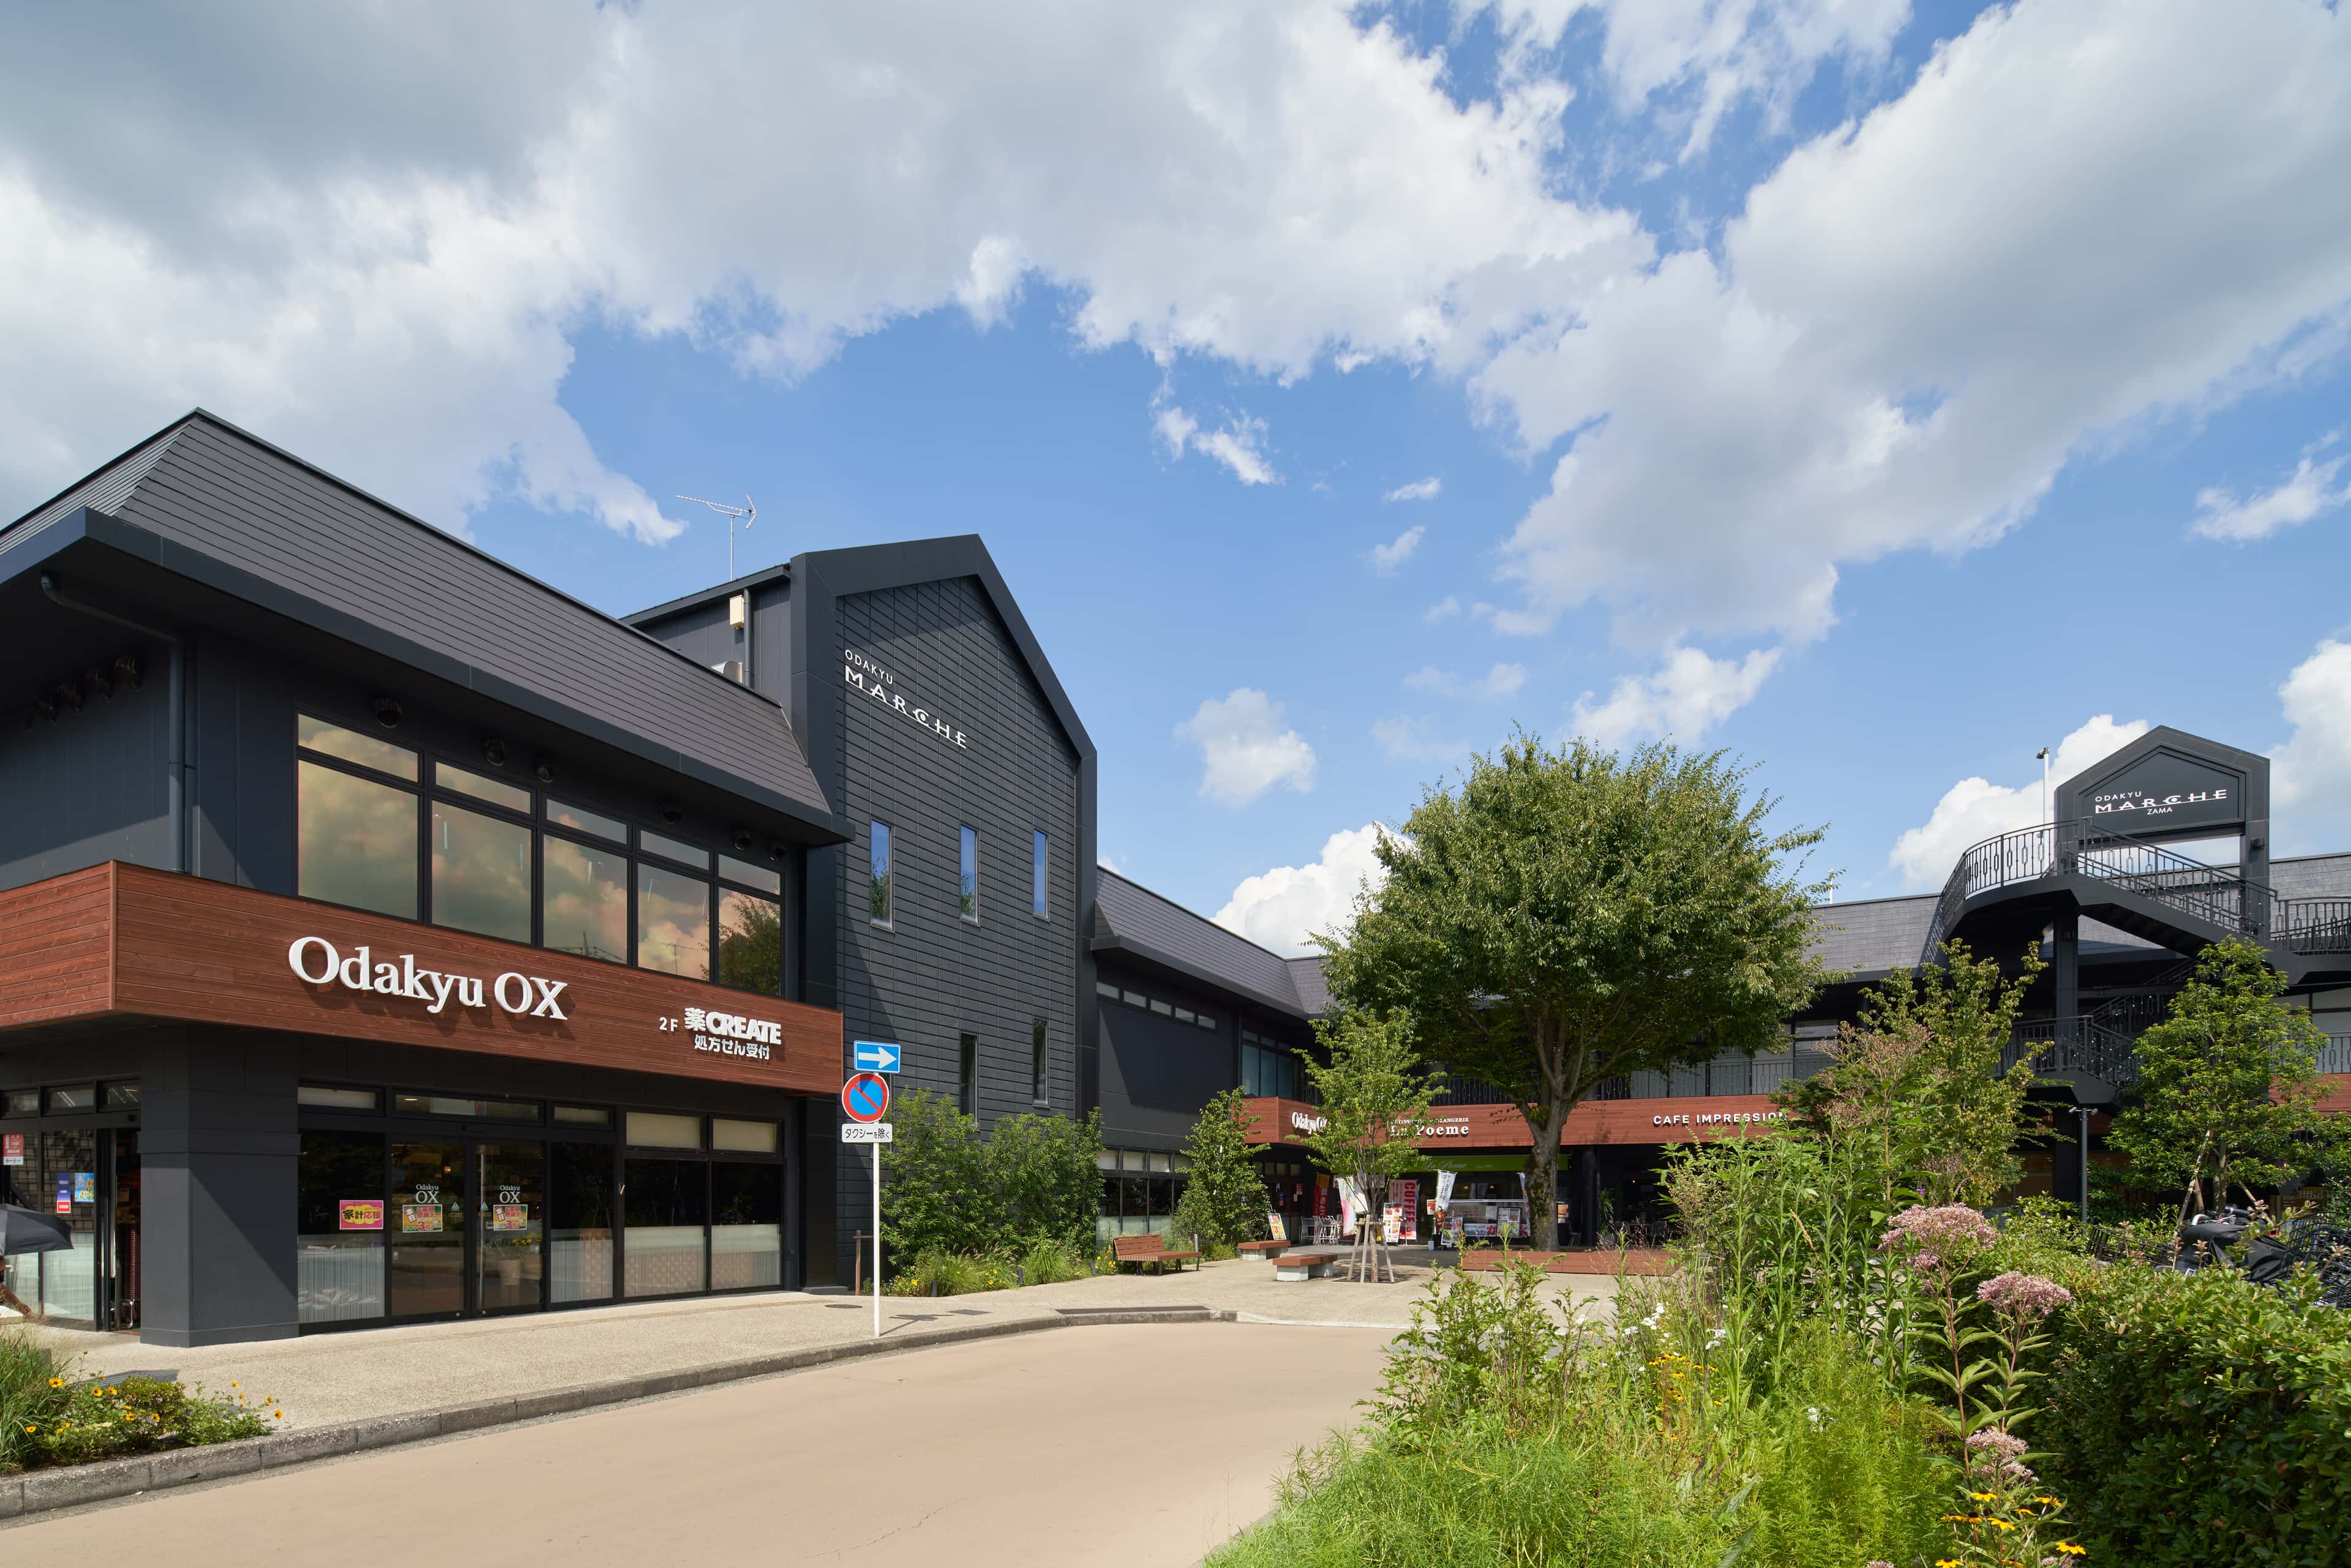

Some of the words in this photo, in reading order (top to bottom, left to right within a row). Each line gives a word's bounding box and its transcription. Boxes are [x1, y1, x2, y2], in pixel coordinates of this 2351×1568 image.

[845, 650, 893, 685] ODAKYU
[845, 665, 967, 749] MARCHE
[2095, 791, 2142, 803] ODAKYU
[2095, 789, 2227, 814] MARCHE
[289, 936, 486, 1013] Odakyu
[494, 972, 568, 1020] OX
[659, 1017, 678, 1032] 2F
[694, 1034, 770, 1060] 処方せん受付
[1654, 1115, 1689, 1124] CAFE
[846, 1128, 890, 1139] タクシーを除く
[1415, 1125, 1469, 1135] Poeme
[416, 1191, 440, 1204] OX
[500, 1191, 521, 1204] OX
[1404, 1182, 1415, 1223] COFFEE
